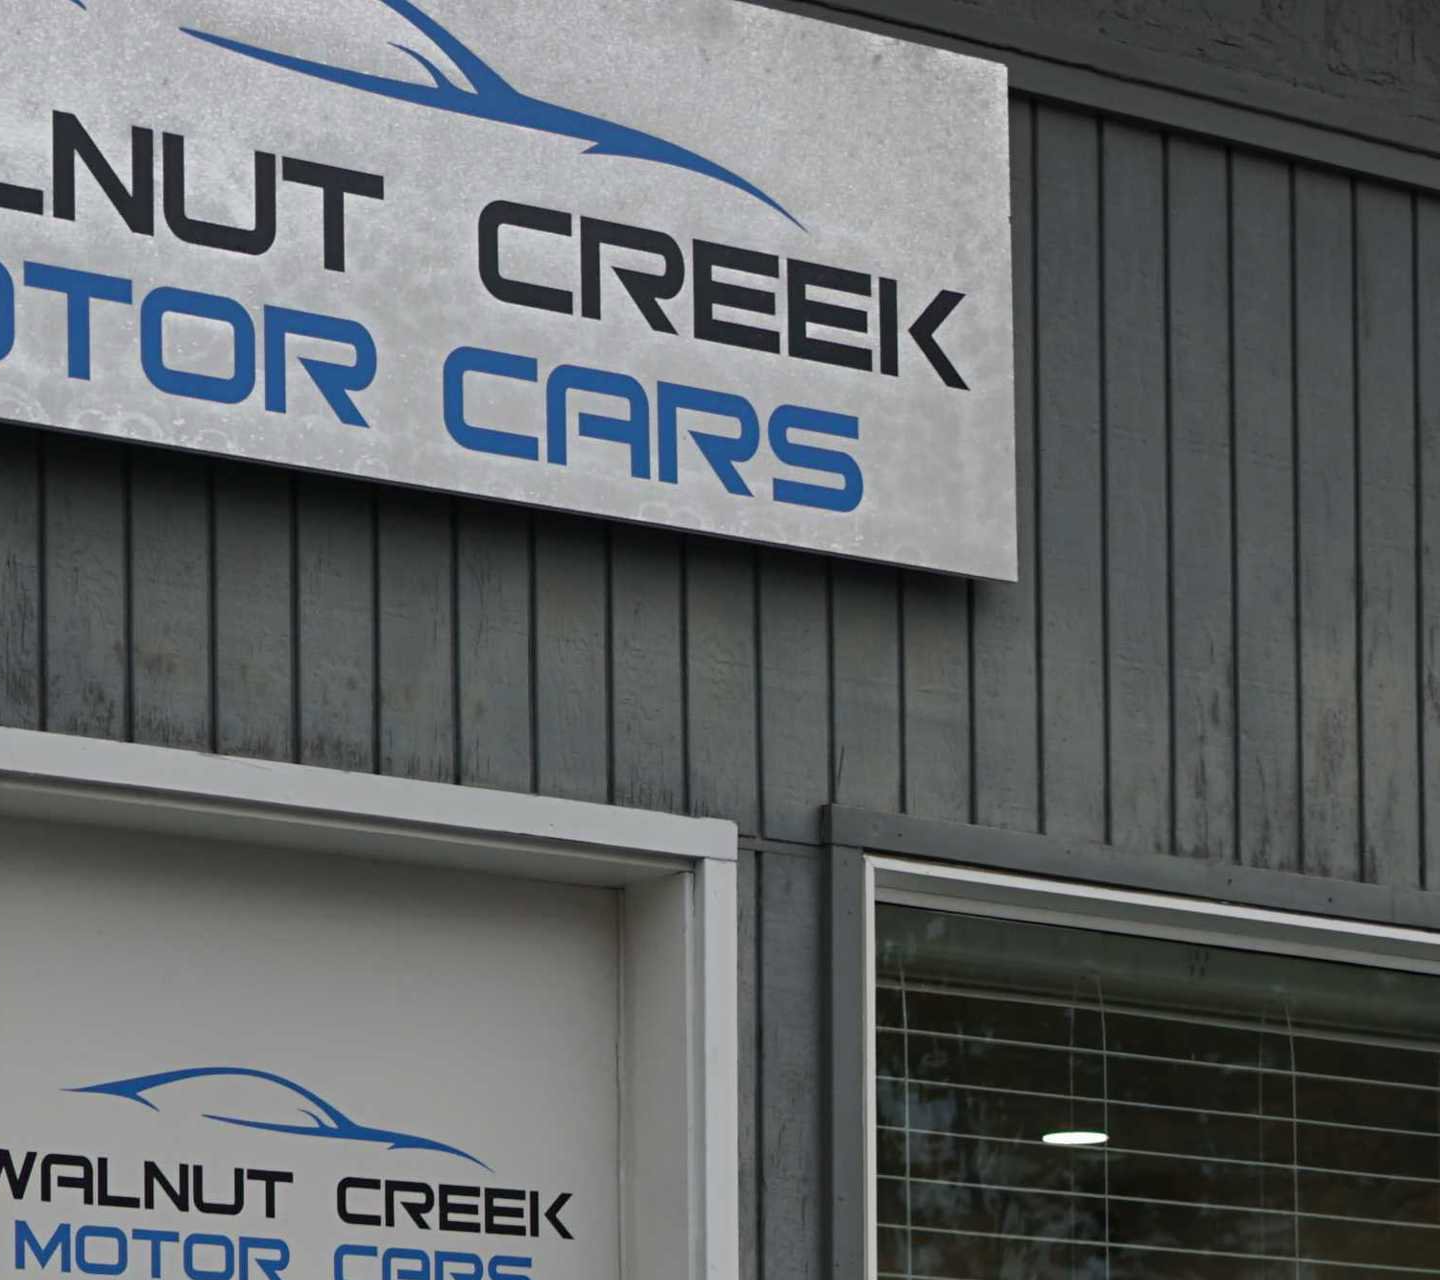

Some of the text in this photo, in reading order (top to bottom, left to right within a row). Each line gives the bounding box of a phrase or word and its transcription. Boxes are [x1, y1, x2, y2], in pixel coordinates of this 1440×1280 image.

[479, 201, 967, 389] CREEK
[444, 347, 863, 511] CARS
[337, 1177, 574, 1239] CREEK
